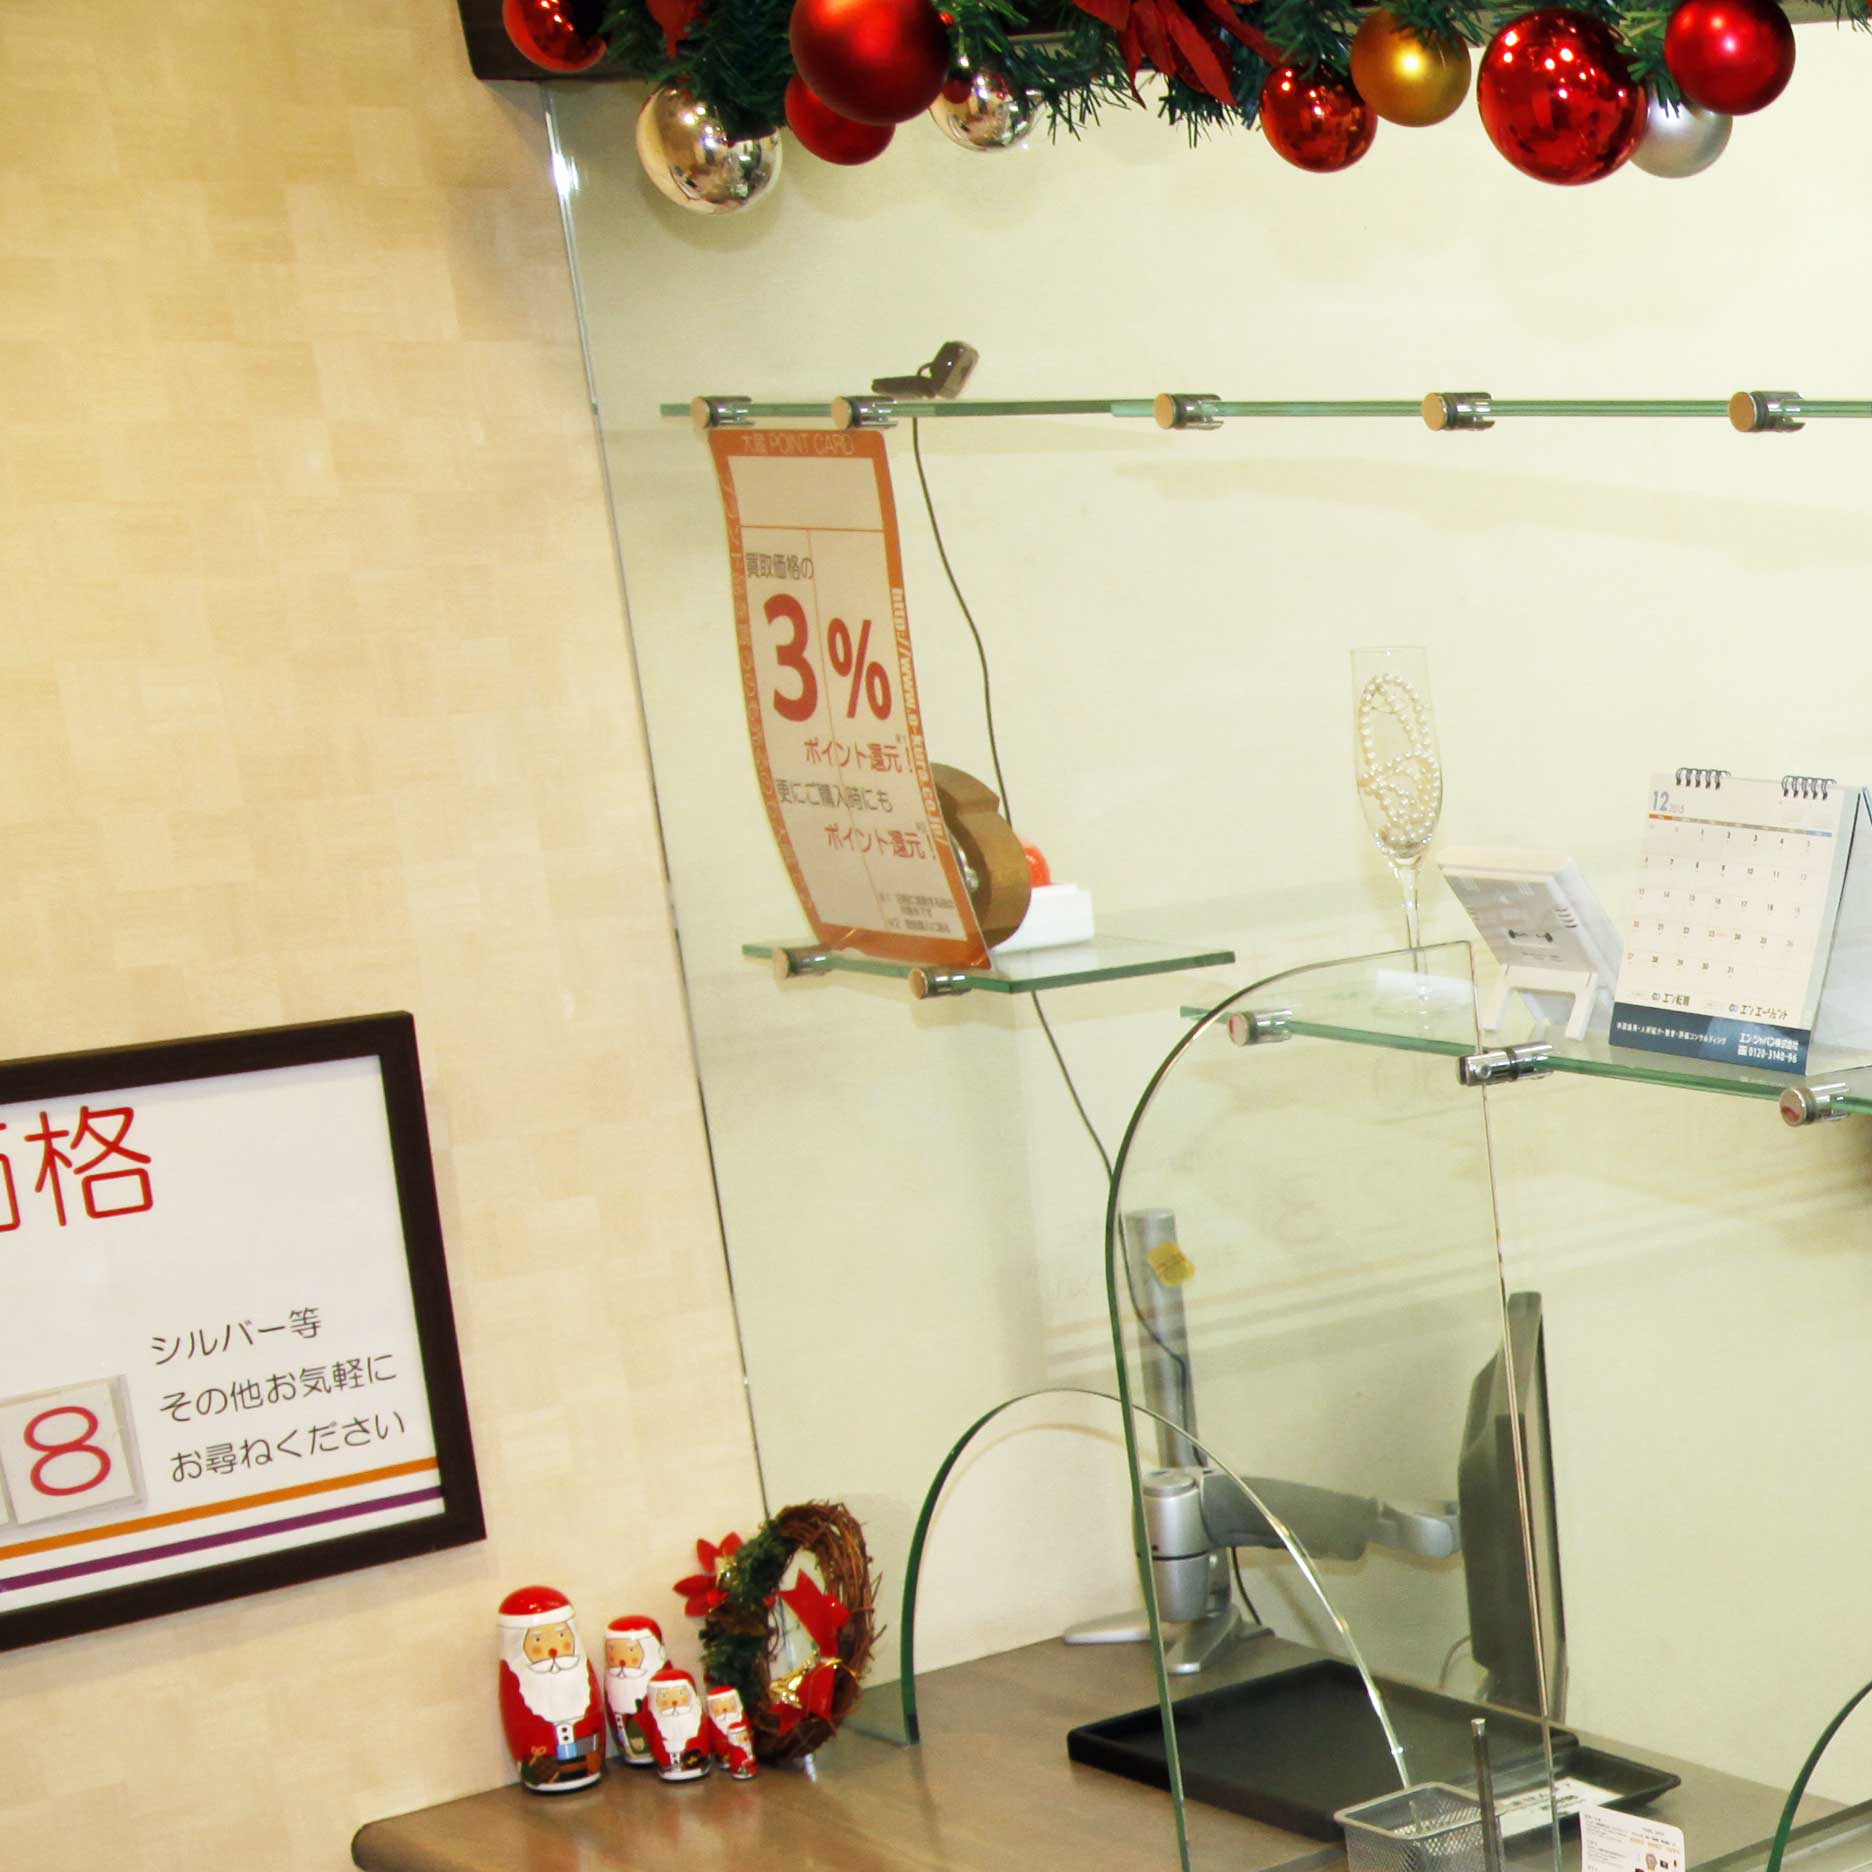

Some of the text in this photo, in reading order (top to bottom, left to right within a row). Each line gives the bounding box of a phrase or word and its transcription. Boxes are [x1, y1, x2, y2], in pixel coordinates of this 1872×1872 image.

[763, 594, 892, 722] 3%
[1652, 790, 1670, 811] 12
[150, 1307, 322, 1366] シルバー等
[159, 1353, 398, 1422] その他お気軽に
[171, 1410, 406, 1482] お尋ねください
